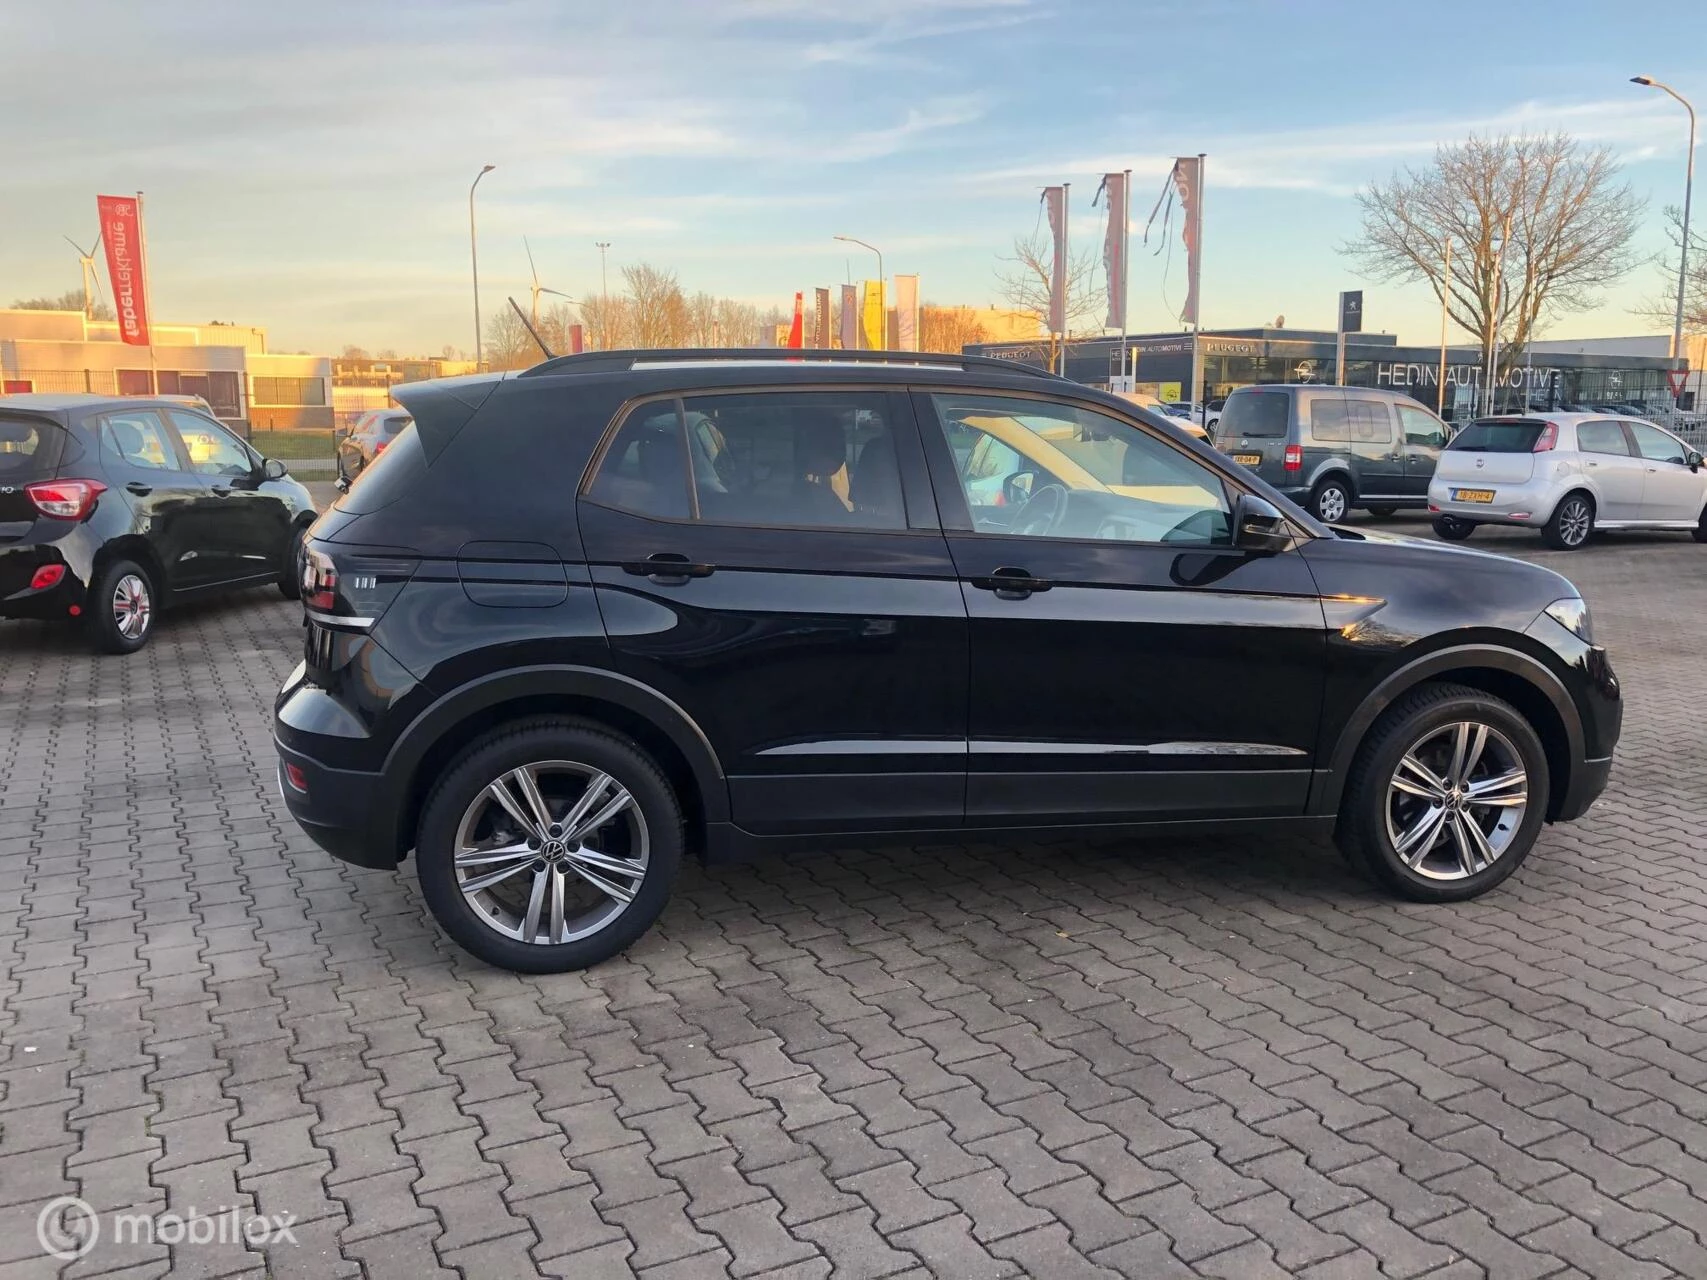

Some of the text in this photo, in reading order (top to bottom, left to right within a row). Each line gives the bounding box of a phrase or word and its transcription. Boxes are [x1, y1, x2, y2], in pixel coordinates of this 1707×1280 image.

[1206, 343, 1256, 353] PEUGEOT
[990, 351, 1032, 360] PEUGEOT
[1377, 363, 1561, 388] HEDIN AUTMOTIVE
